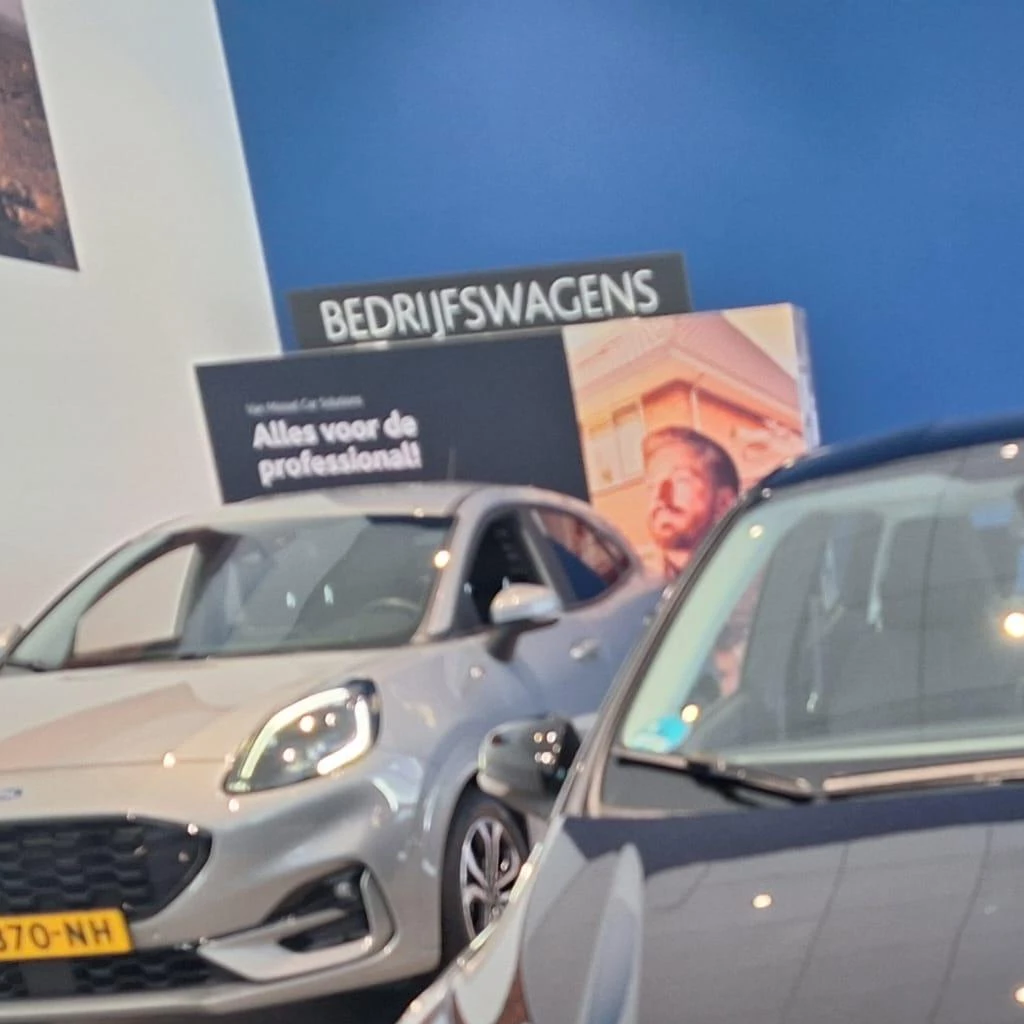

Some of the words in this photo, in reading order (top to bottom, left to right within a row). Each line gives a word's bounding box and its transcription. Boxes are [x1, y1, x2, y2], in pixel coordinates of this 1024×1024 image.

[319, 268, 659, 340] BEDRIJFSWAGENS
[253, 419, 319, 449] Alles
[319, 418, 380, 443] voor
[383, 409, 419, 439] de
[258, 440, 421, 487] professional!
